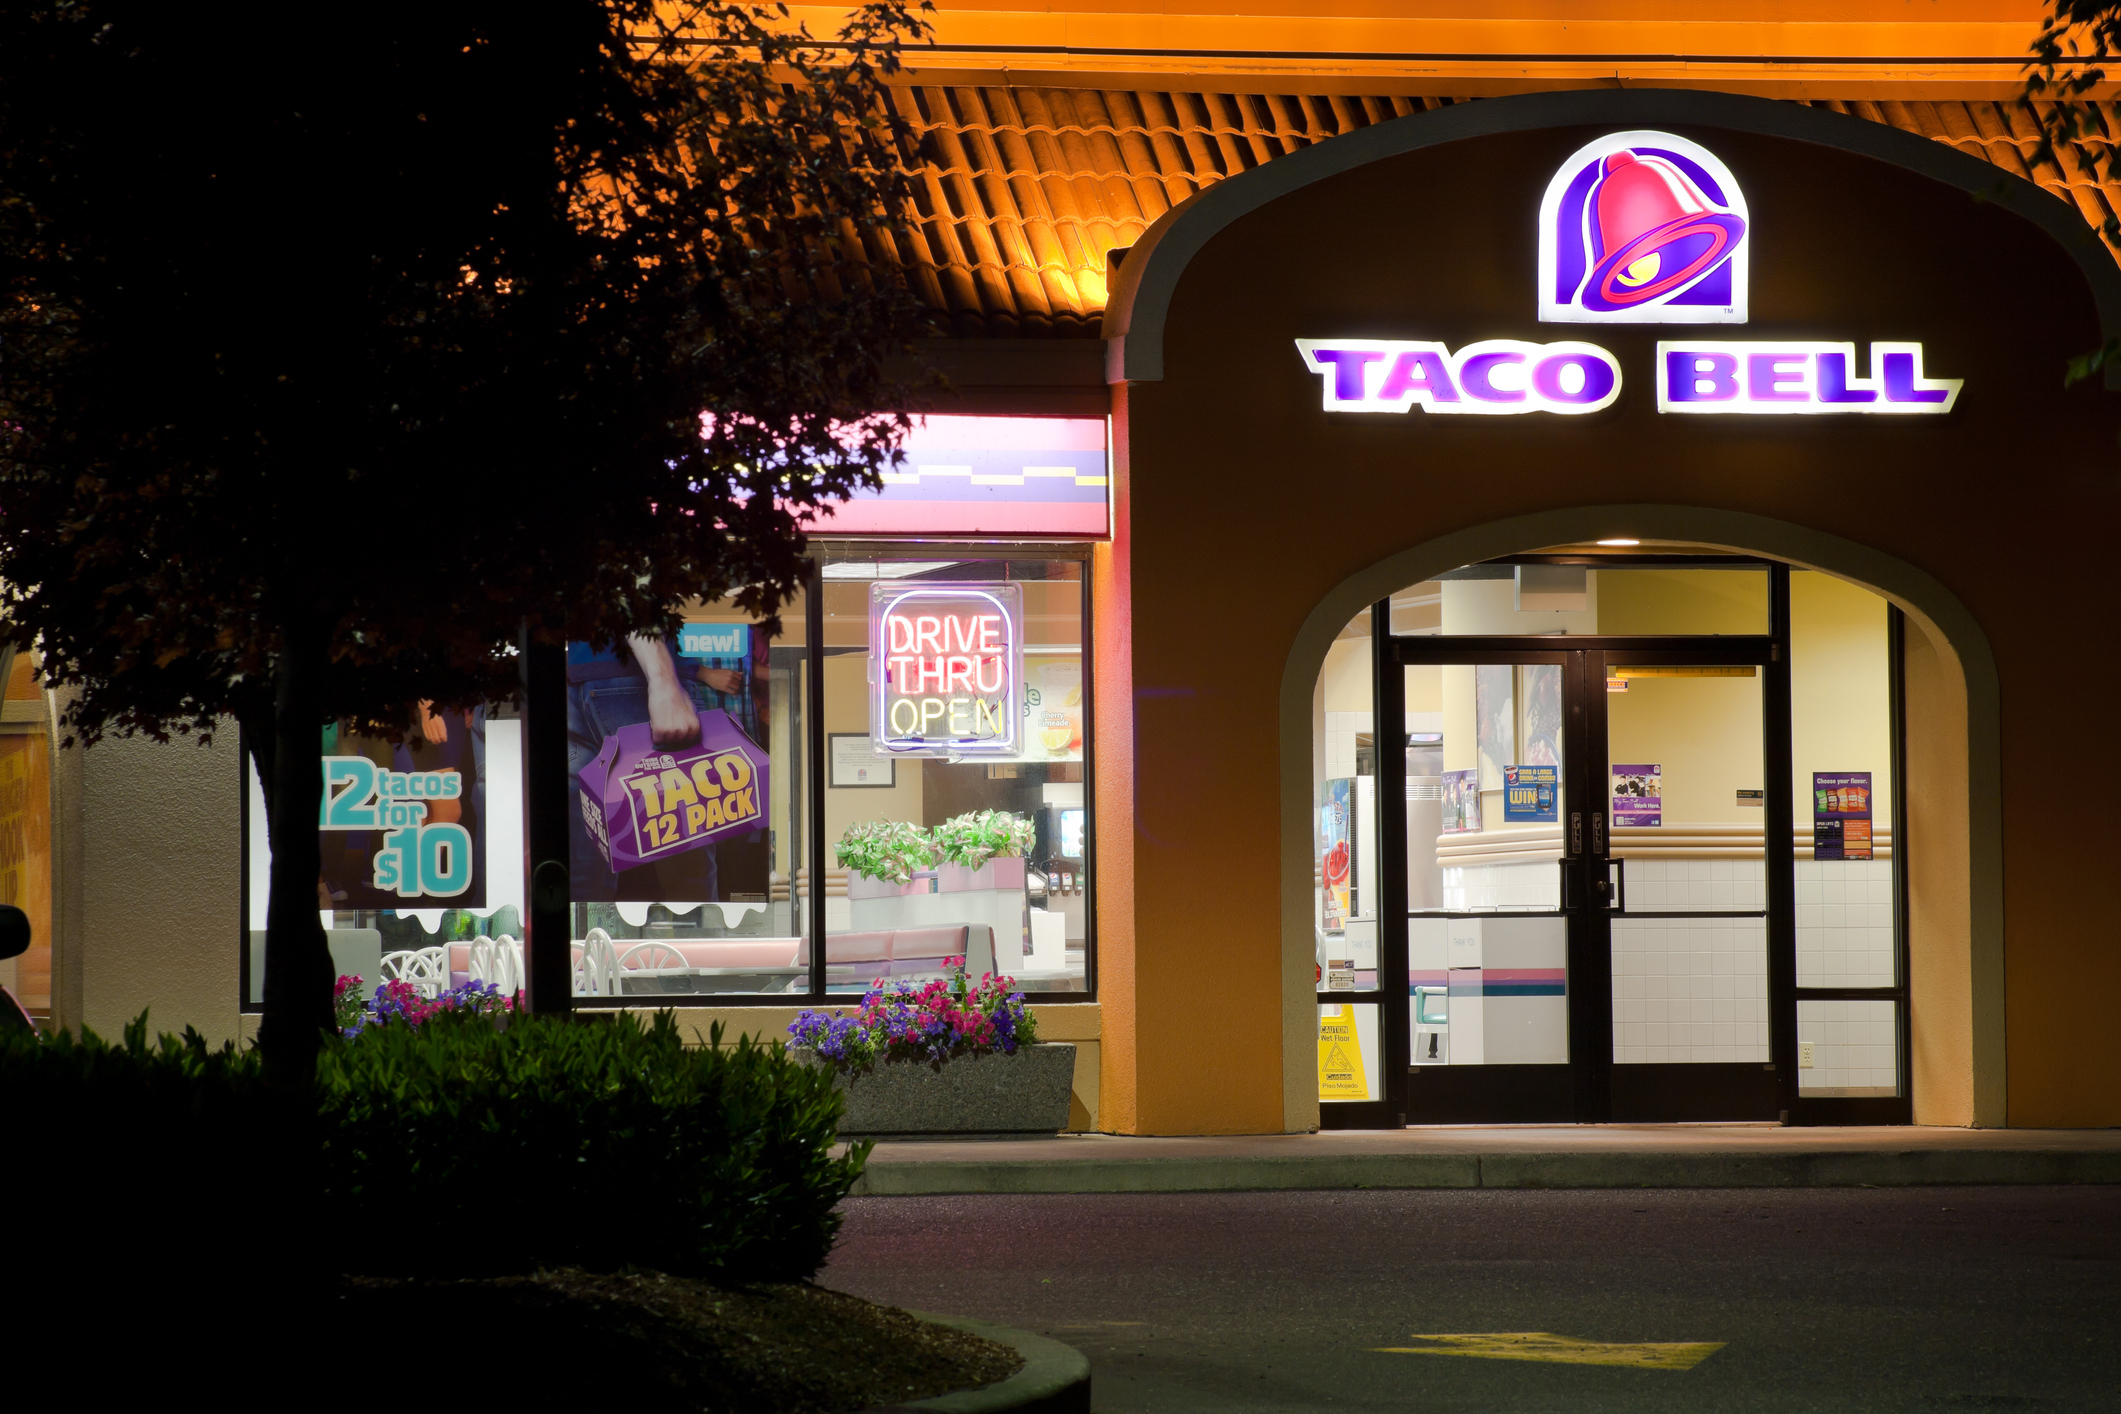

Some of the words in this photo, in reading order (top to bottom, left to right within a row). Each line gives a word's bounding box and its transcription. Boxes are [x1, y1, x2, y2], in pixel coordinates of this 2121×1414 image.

[1308, 346, 1618, 407] TACO
[1663, 348, 1953, 406] BELL
[684, 629, 740, 653] new!
[888, 614, 1001, 654] DRIVE
[888, 655, 1002, 693] THRU
[890, 697, 1002, 735] OPEN
[1038, 718, 1070, 727] Limeade
[1041, 711, 1065, 720] Cherry
[378, 771, 458, 796] tacos
[628, 754, 751, 818] TACO
[378, 798, 424, 826] for
[642, 813, 680, 848] 12
[686, 787, 756, 836] PACK
[378, 827, 469, 893] $10
[1364, 940, 1373, 949] YOU
[1467, 937, 1475, 947] YOU
[1320, 1026, 1348, 1034] CAUTION
[1320, 1034, 1333, 1042] Wet
[1334, 1034, 1350, 1042] Floor
